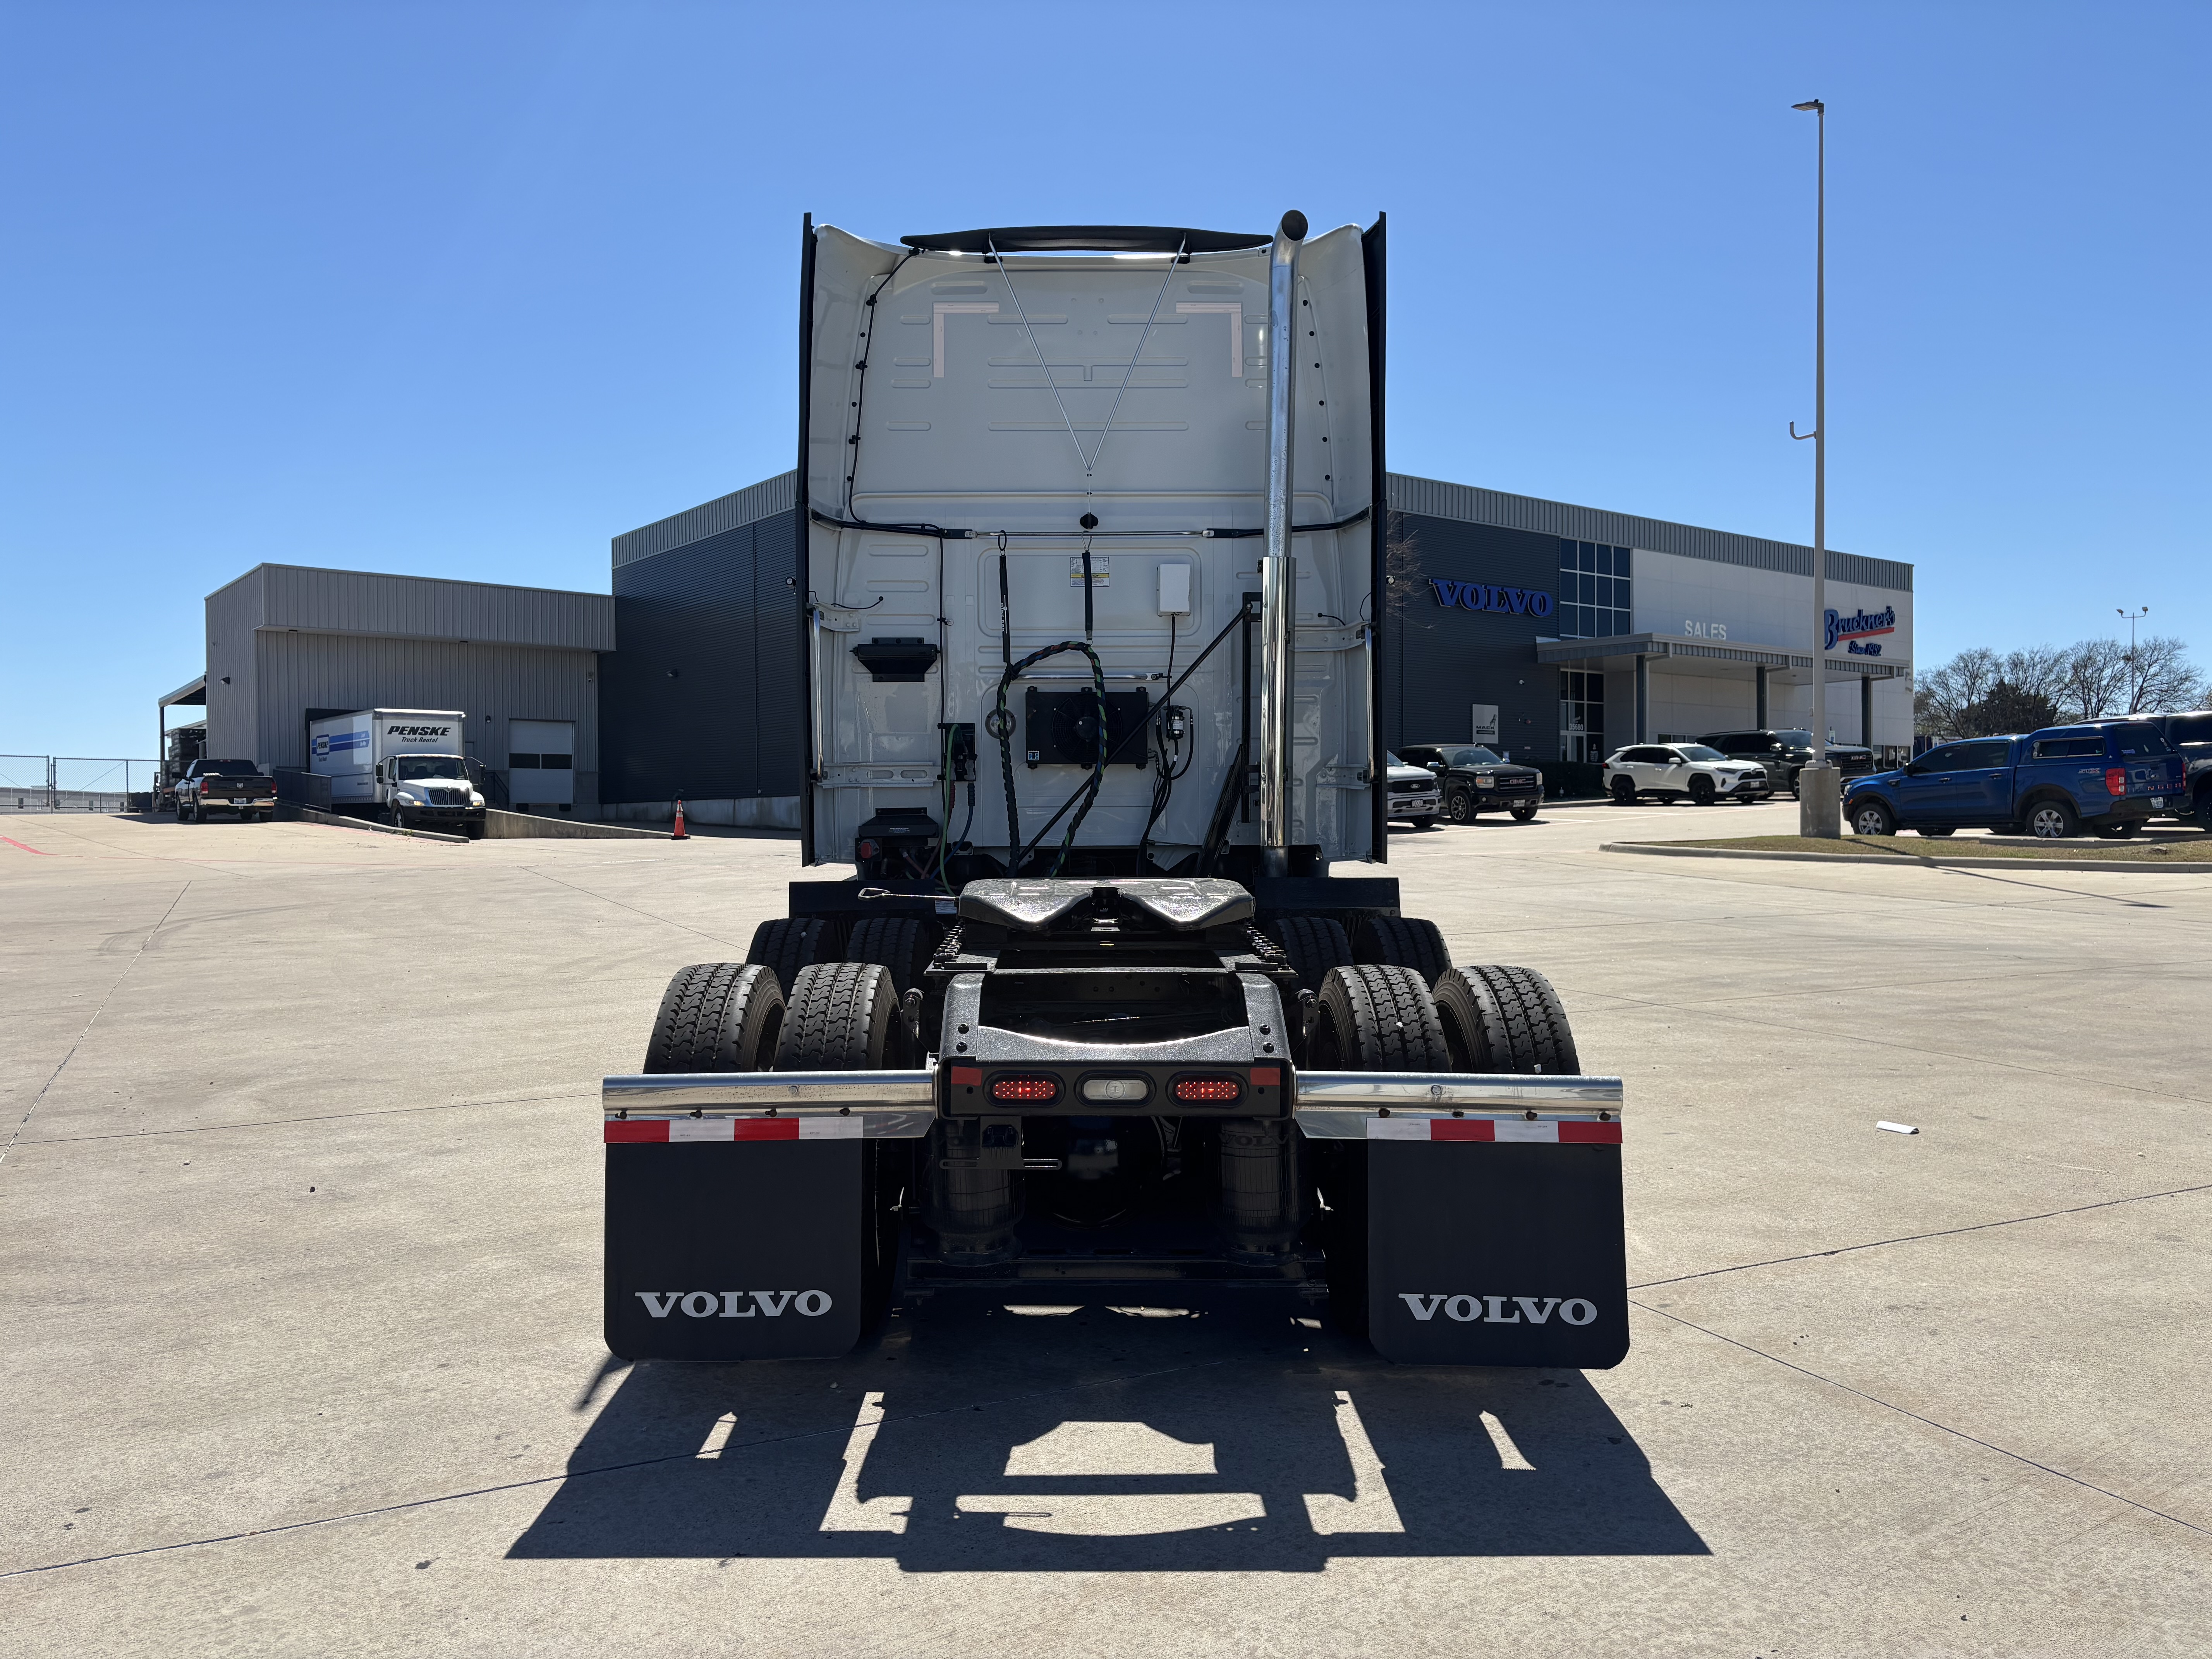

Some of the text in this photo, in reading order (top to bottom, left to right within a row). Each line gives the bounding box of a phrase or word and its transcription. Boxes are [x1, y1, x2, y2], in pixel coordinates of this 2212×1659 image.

[1429, 579, 1553, 617] VOLVO
[1685, 620, 1726, 641] SALES
[387, 726, 451, 736] PENSKE
[317, 741, 328, 749] PENSKE
[635, 1290, 833, 1318] VOLVO
[1398, 1293, 1598, 1326] VOLVO
